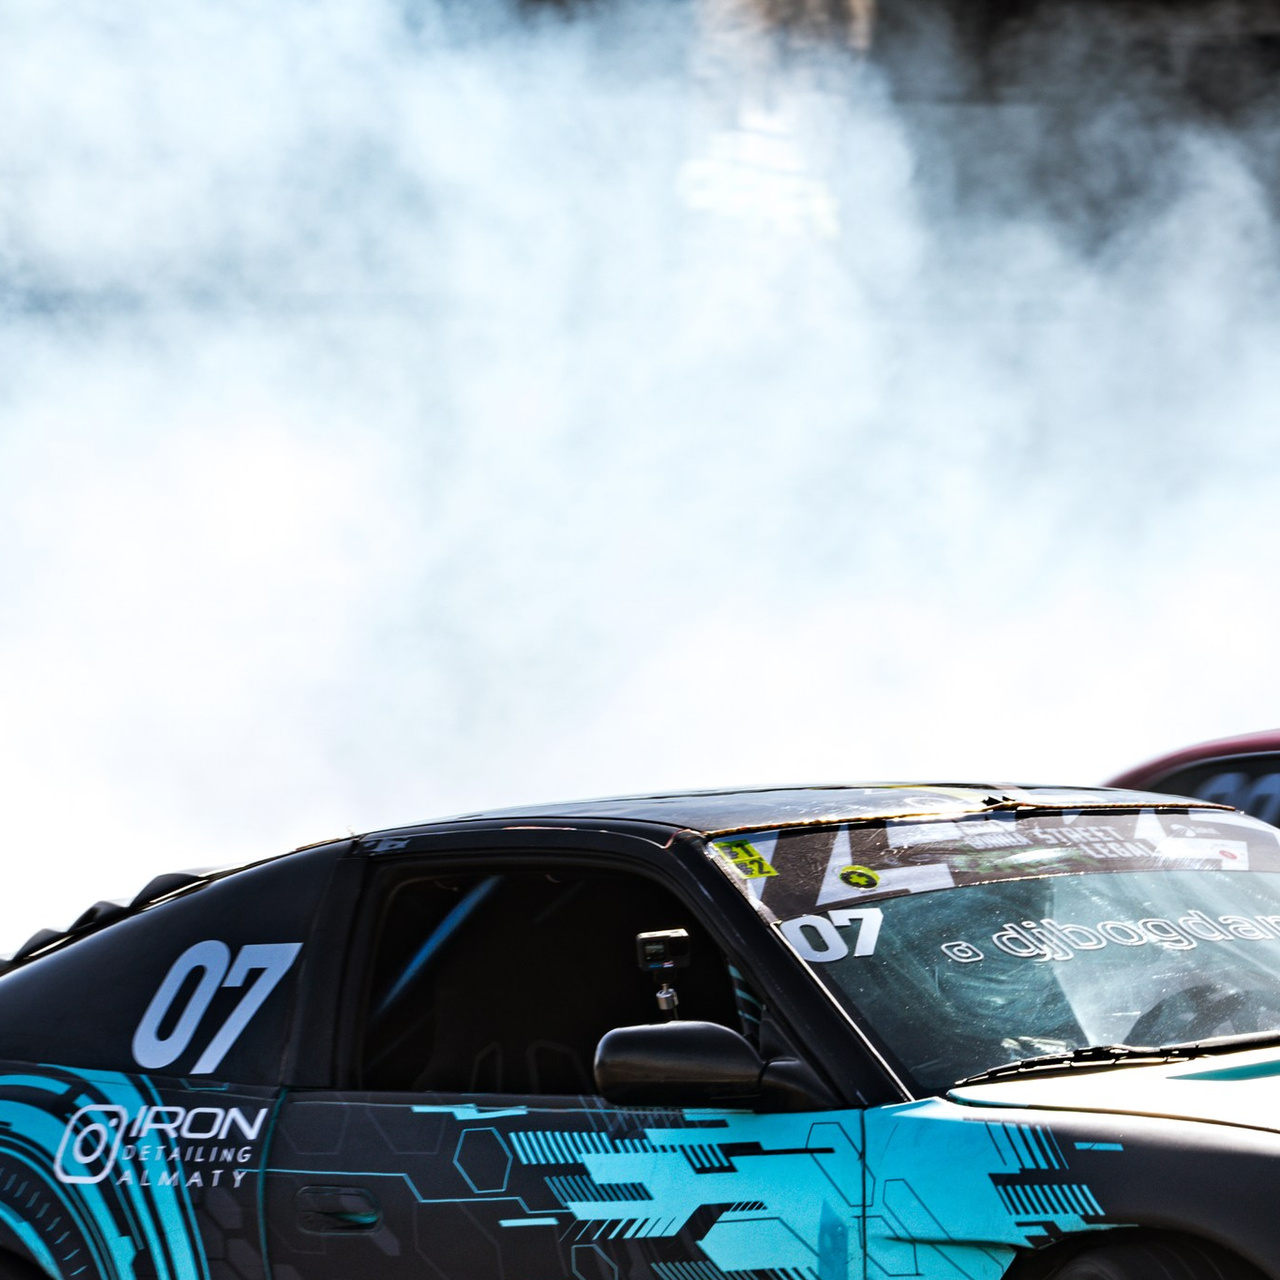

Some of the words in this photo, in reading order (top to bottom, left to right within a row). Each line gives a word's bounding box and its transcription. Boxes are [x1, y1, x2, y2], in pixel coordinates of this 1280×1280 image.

[1034, 826, 1123, 844] STREET
[780, 908, 884, 962] 07
[132, 939, 304, 1075] 07
[128, 1105, 269, 1140] IRON
[121, 1144, 253, 1163] DETAILING
[115, 1168, 248, 1188] ALMATY
